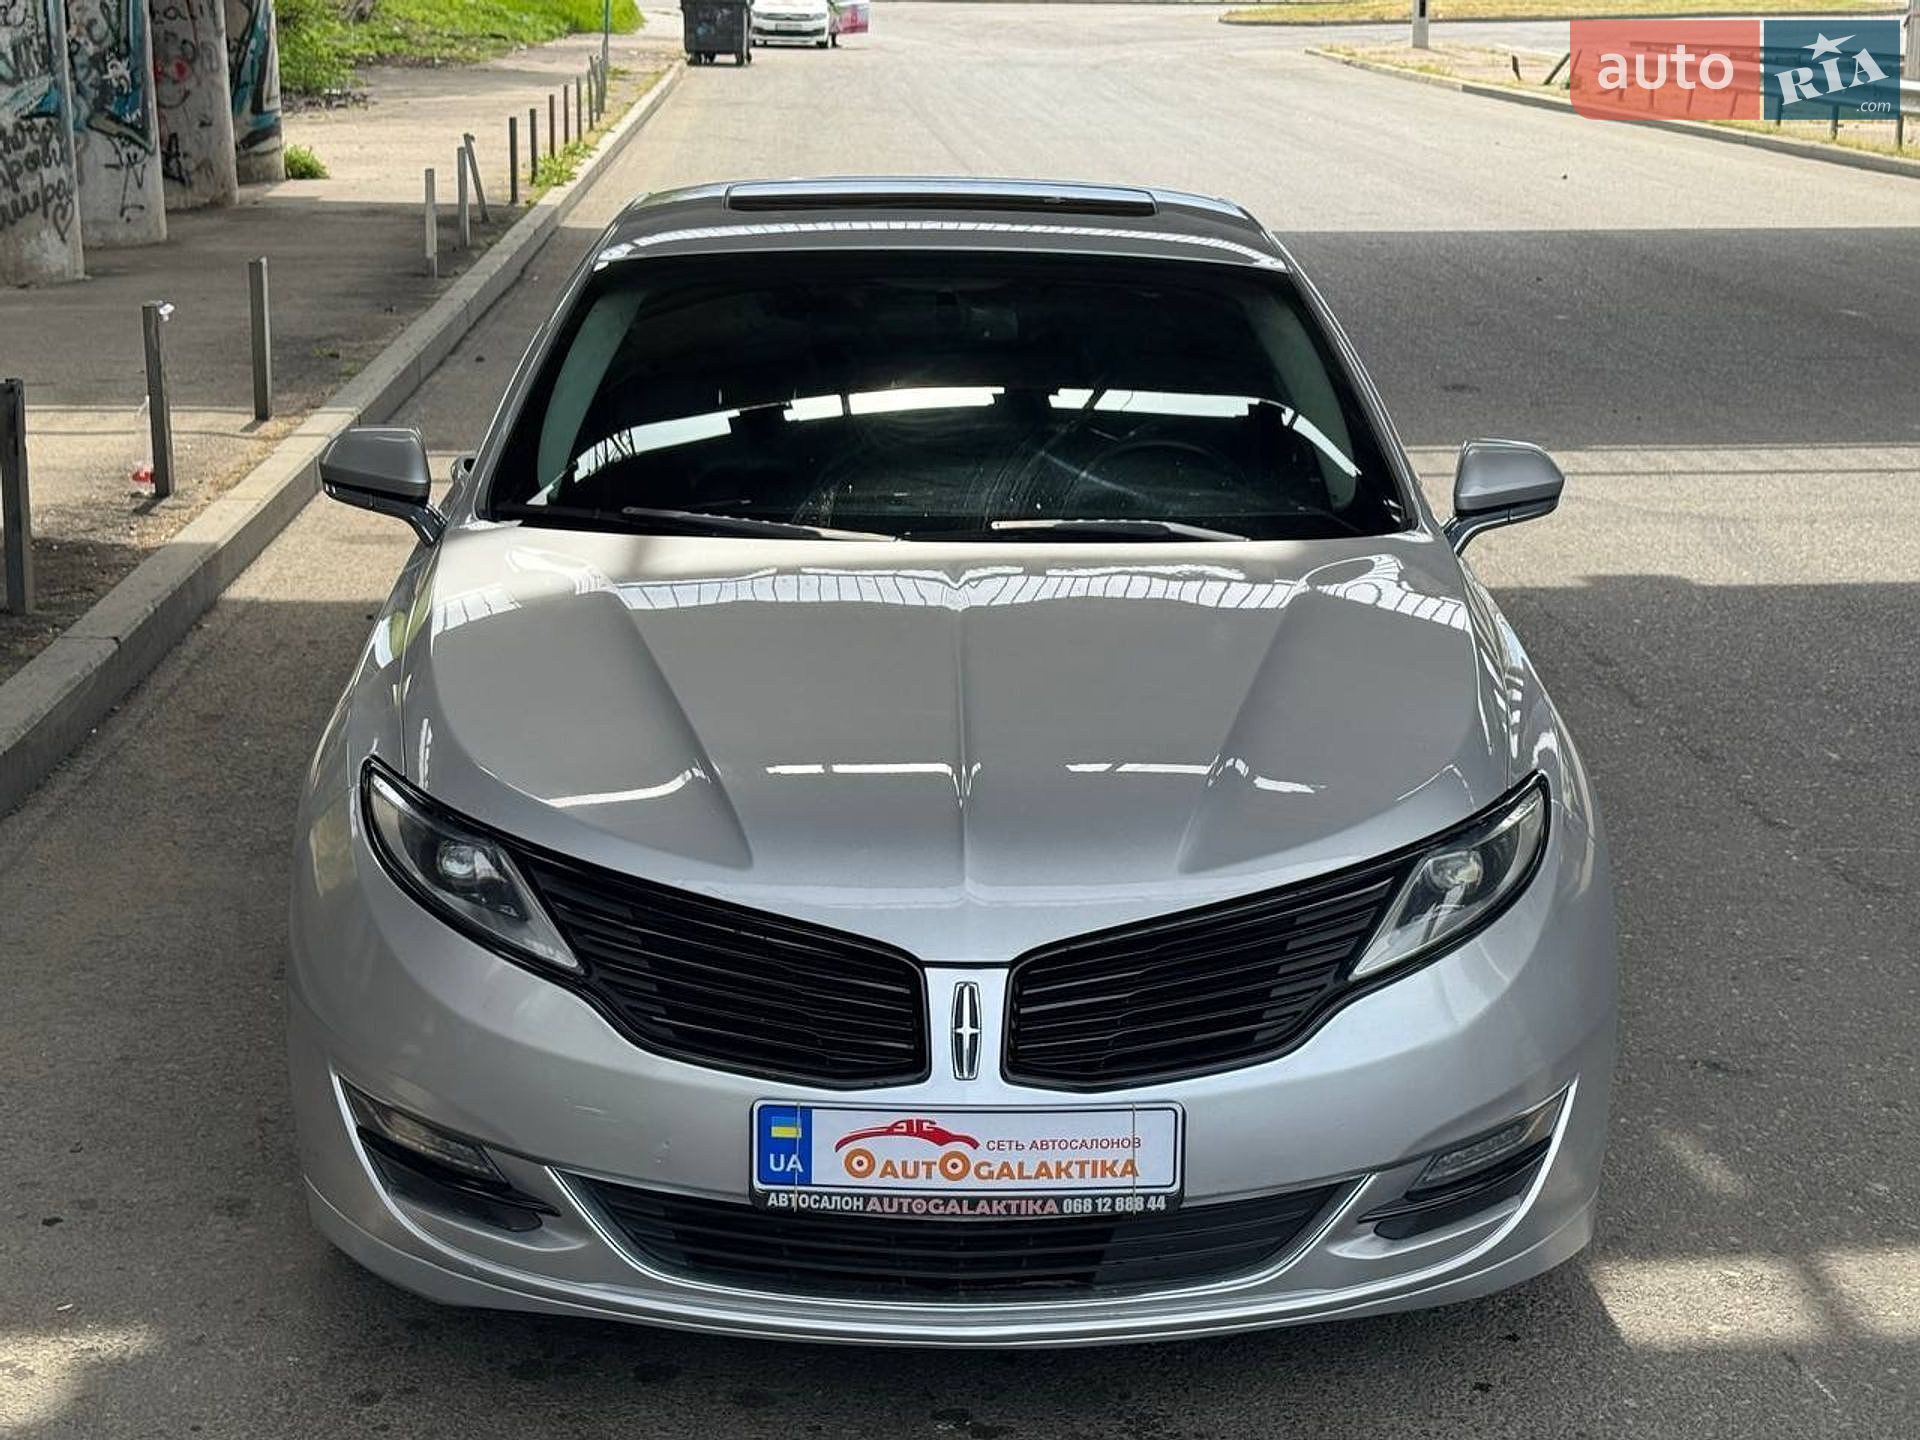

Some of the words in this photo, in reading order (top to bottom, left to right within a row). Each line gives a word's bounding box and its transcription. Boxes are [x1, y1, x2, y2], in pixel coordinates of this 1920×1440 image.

[986, 1139, 1025, 1151] СЕТЬ
[1029, 1136, 1142, 1151] АВТОСАЛОНОВ
[769, 1153, 804, 1172] UA
[767, 1192, 864, 1211] АВТОСАЛОН
[865, 1197, 1059, 1215] AUTOGALAKTIKA
[1062, 1198, 1092, 1213] 068
[1095, 1197, 1112, 1212] 12
[1147, 1195, 1167, 1210] 44
